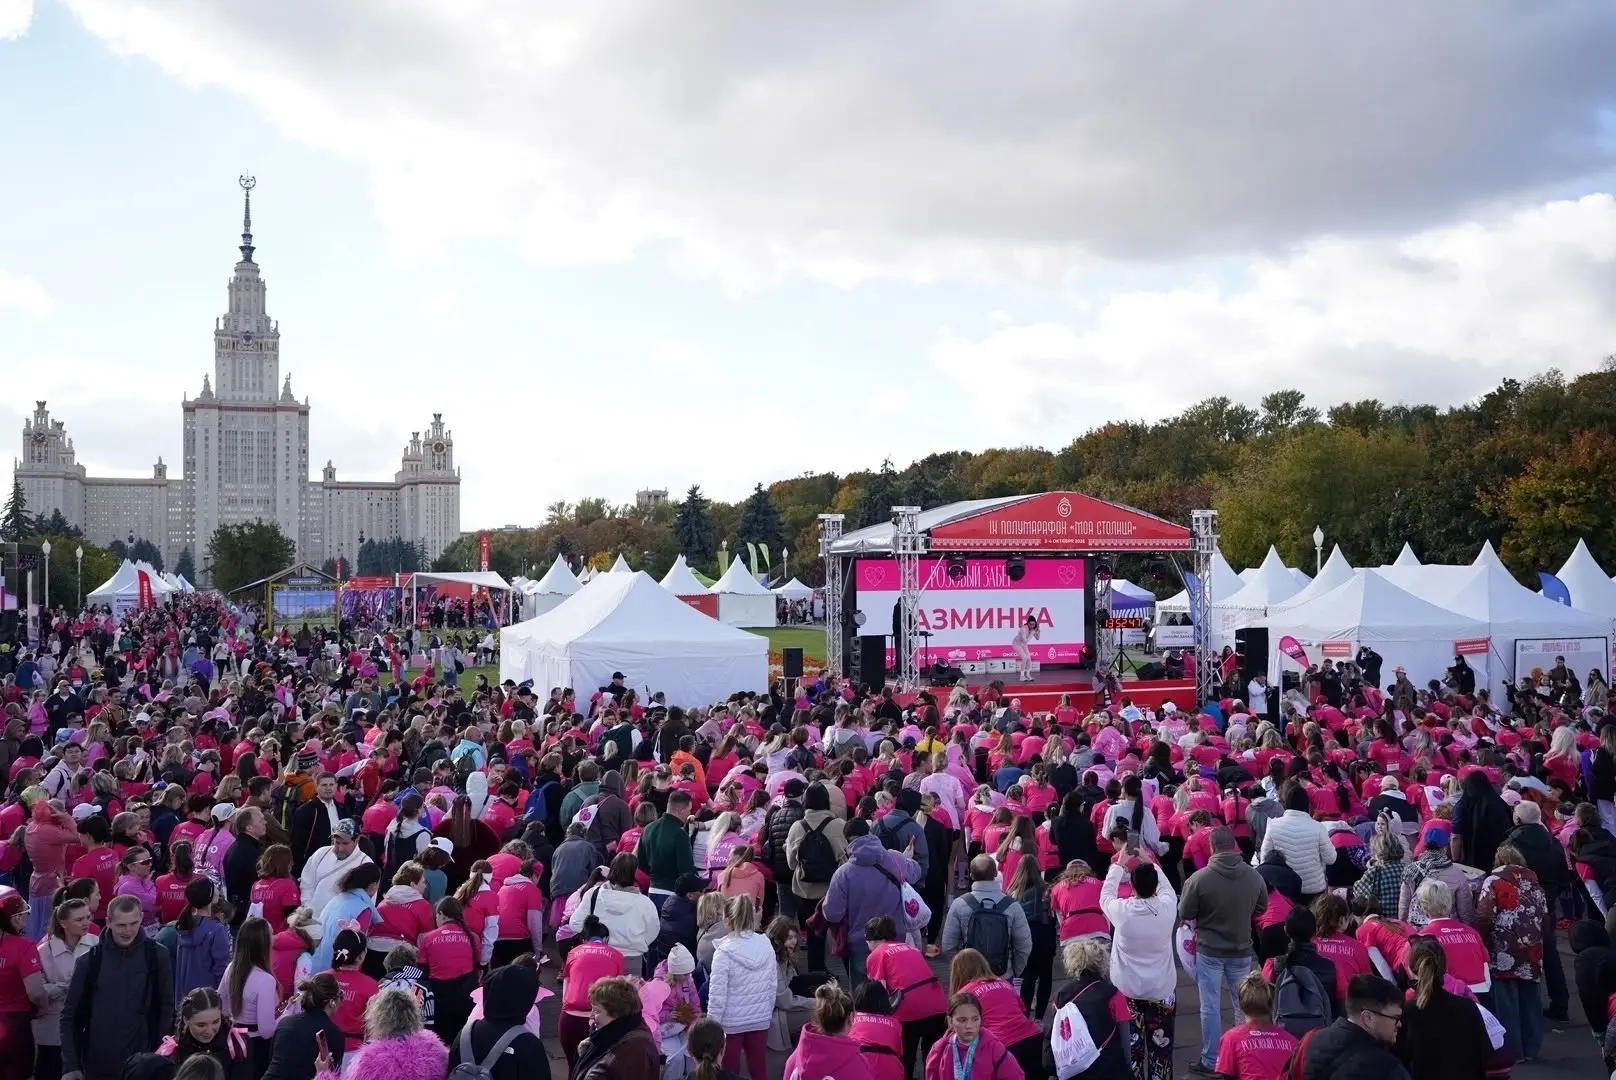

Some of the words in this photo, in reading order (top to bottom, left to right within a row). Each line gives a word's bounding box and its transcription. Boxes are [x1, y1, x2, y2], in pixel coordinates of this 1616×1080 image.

[1000, 520, 1067, 535] ПОЛУМАРАФОН
[1069, 520, 1094, 535] «МОЯ
[918, 607, 1054, 631] АЗМИНКА
